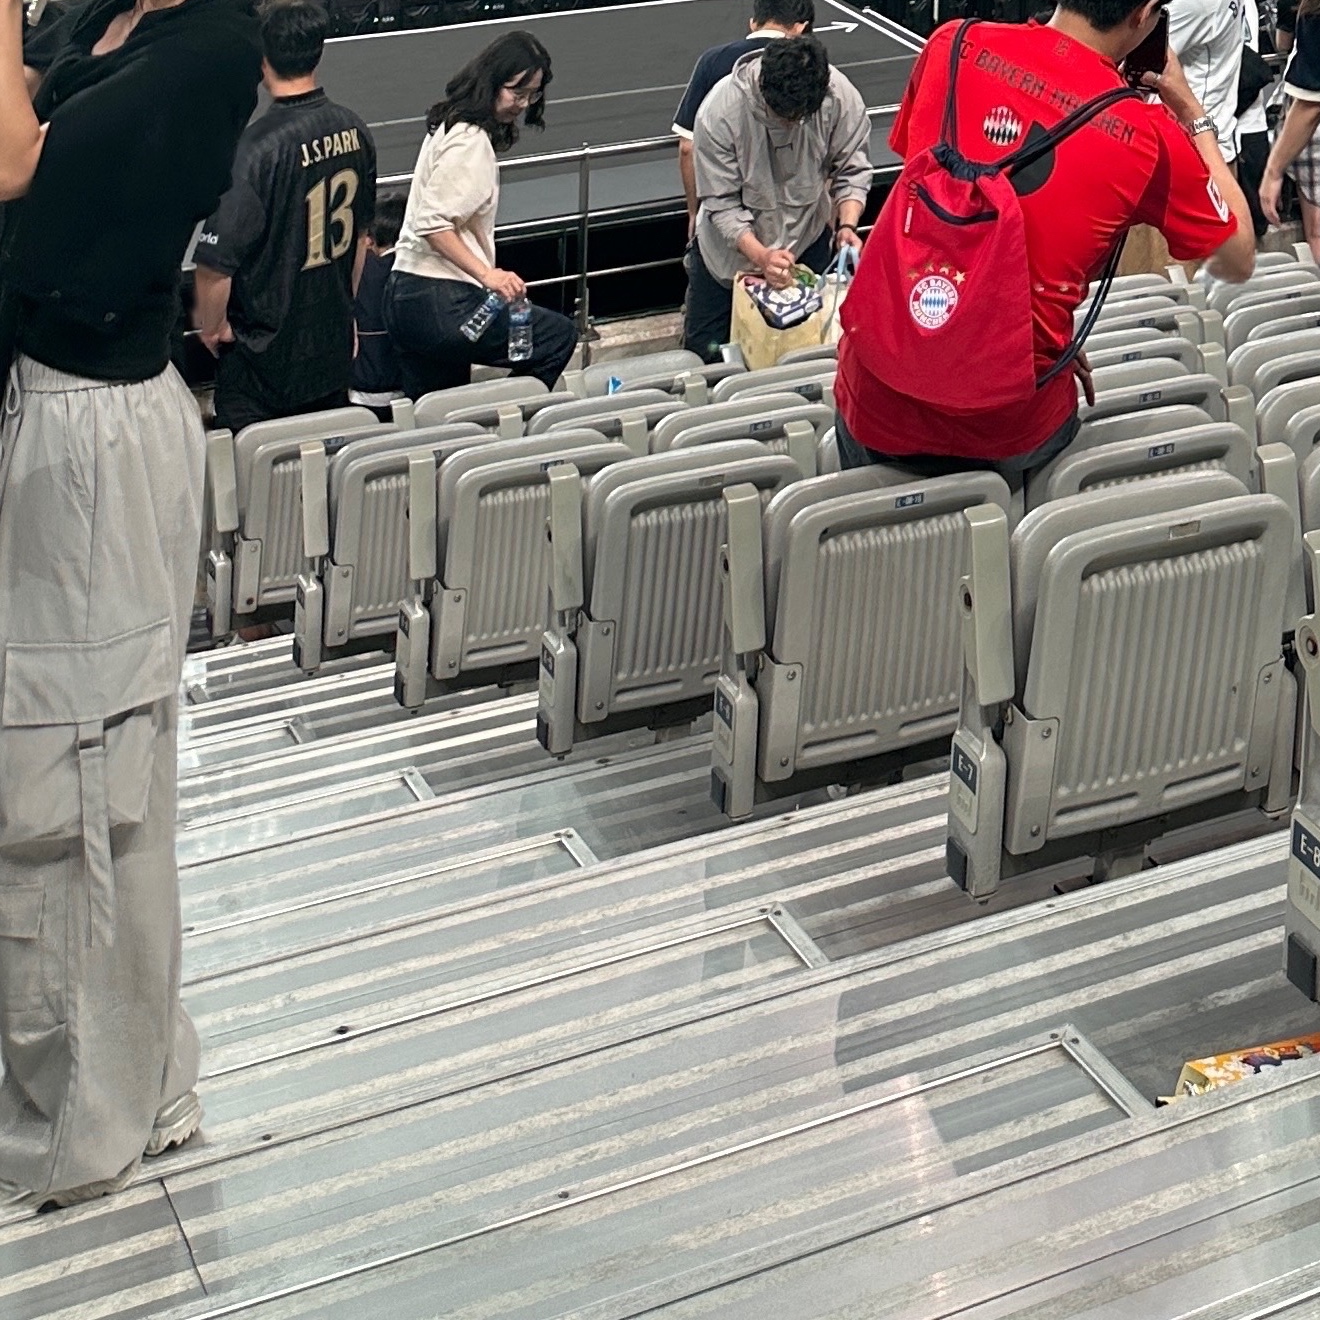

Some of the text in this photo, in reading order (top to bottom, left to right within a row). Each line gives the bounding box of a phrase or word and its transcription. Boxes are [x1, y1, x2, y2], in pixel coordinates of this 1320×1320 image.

[975, 48, 1047, 99] BAYERN
[199, 231, 219, 245] orld
[301, 167, 360, 272] 13
